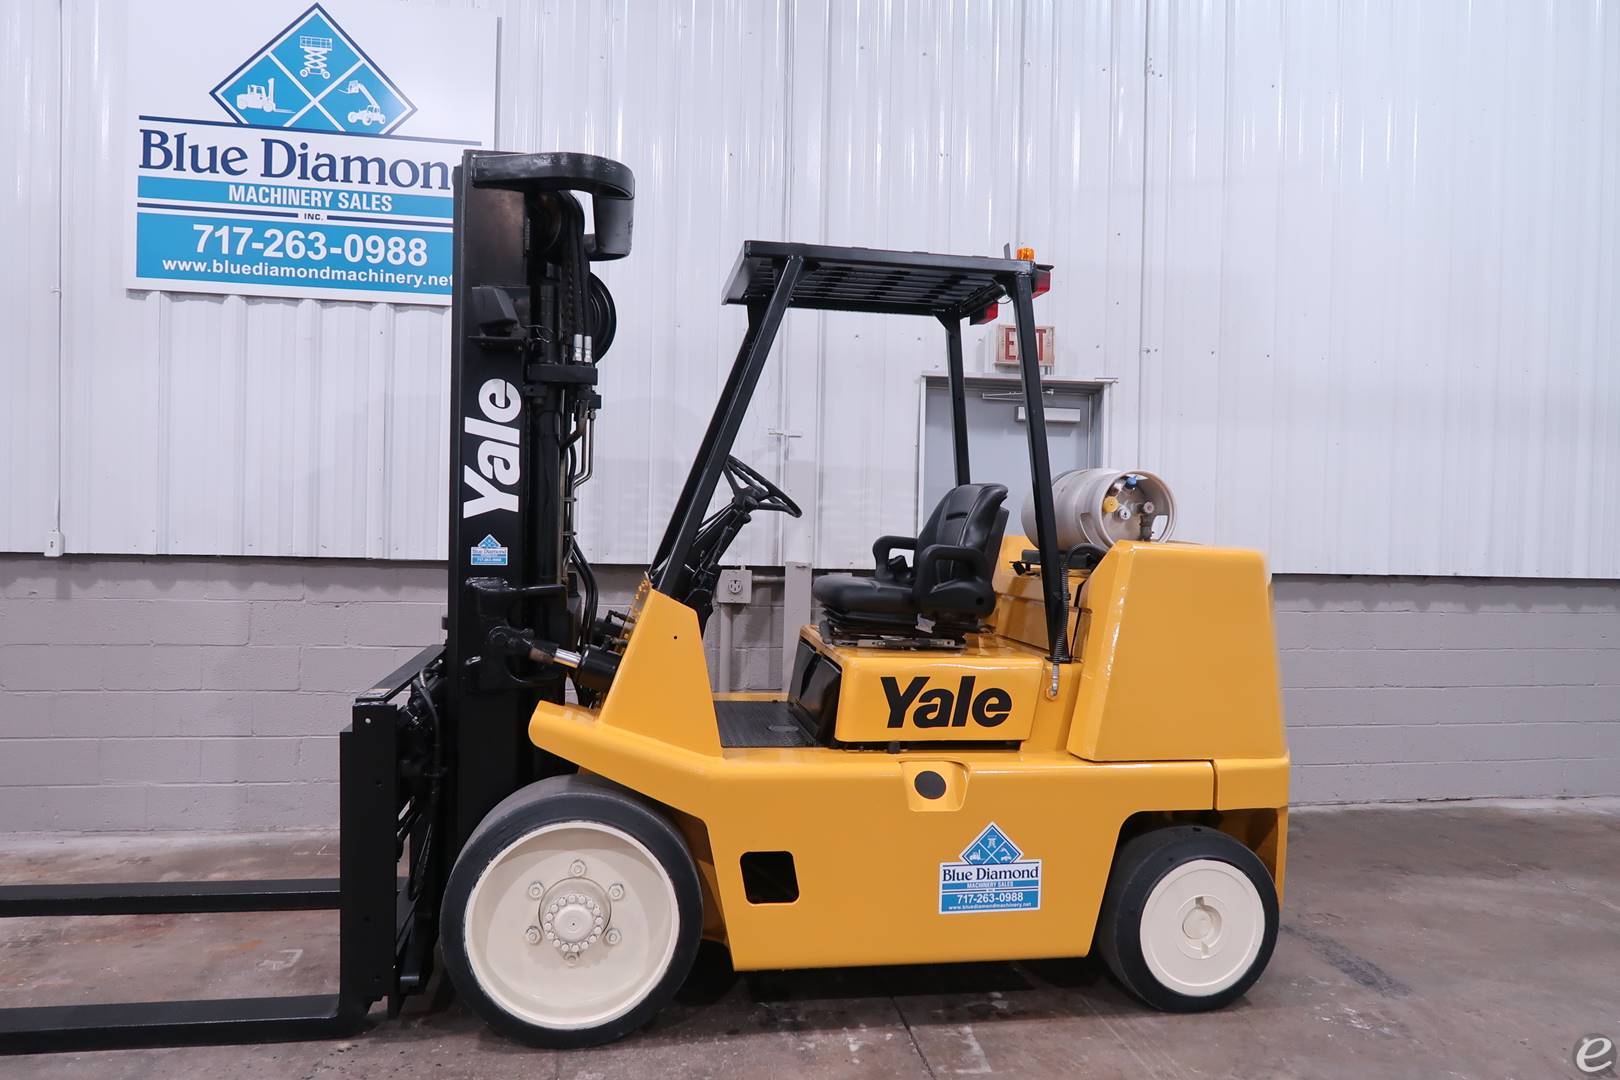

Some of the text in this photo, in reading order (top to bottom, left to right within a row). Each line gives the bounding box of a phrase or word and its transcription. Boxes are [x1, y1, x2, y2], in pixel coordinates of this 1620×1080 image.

[139, 129, 454, 190] Blue Diamon
[229, 184, 393, 212] MACHINERY SALES
[304, 213, 324, 221] INC.
[193, 224, 428, 267] 717-263-0988
[1005, 328, 1047, 361] ET
[463, 378, 522, 519] Yale
[880, 676, 1013, 729] Yale
[942, 866, 1039, 882] Blue Diamond
[957, 892, 1024, 905] 717-263-0988
